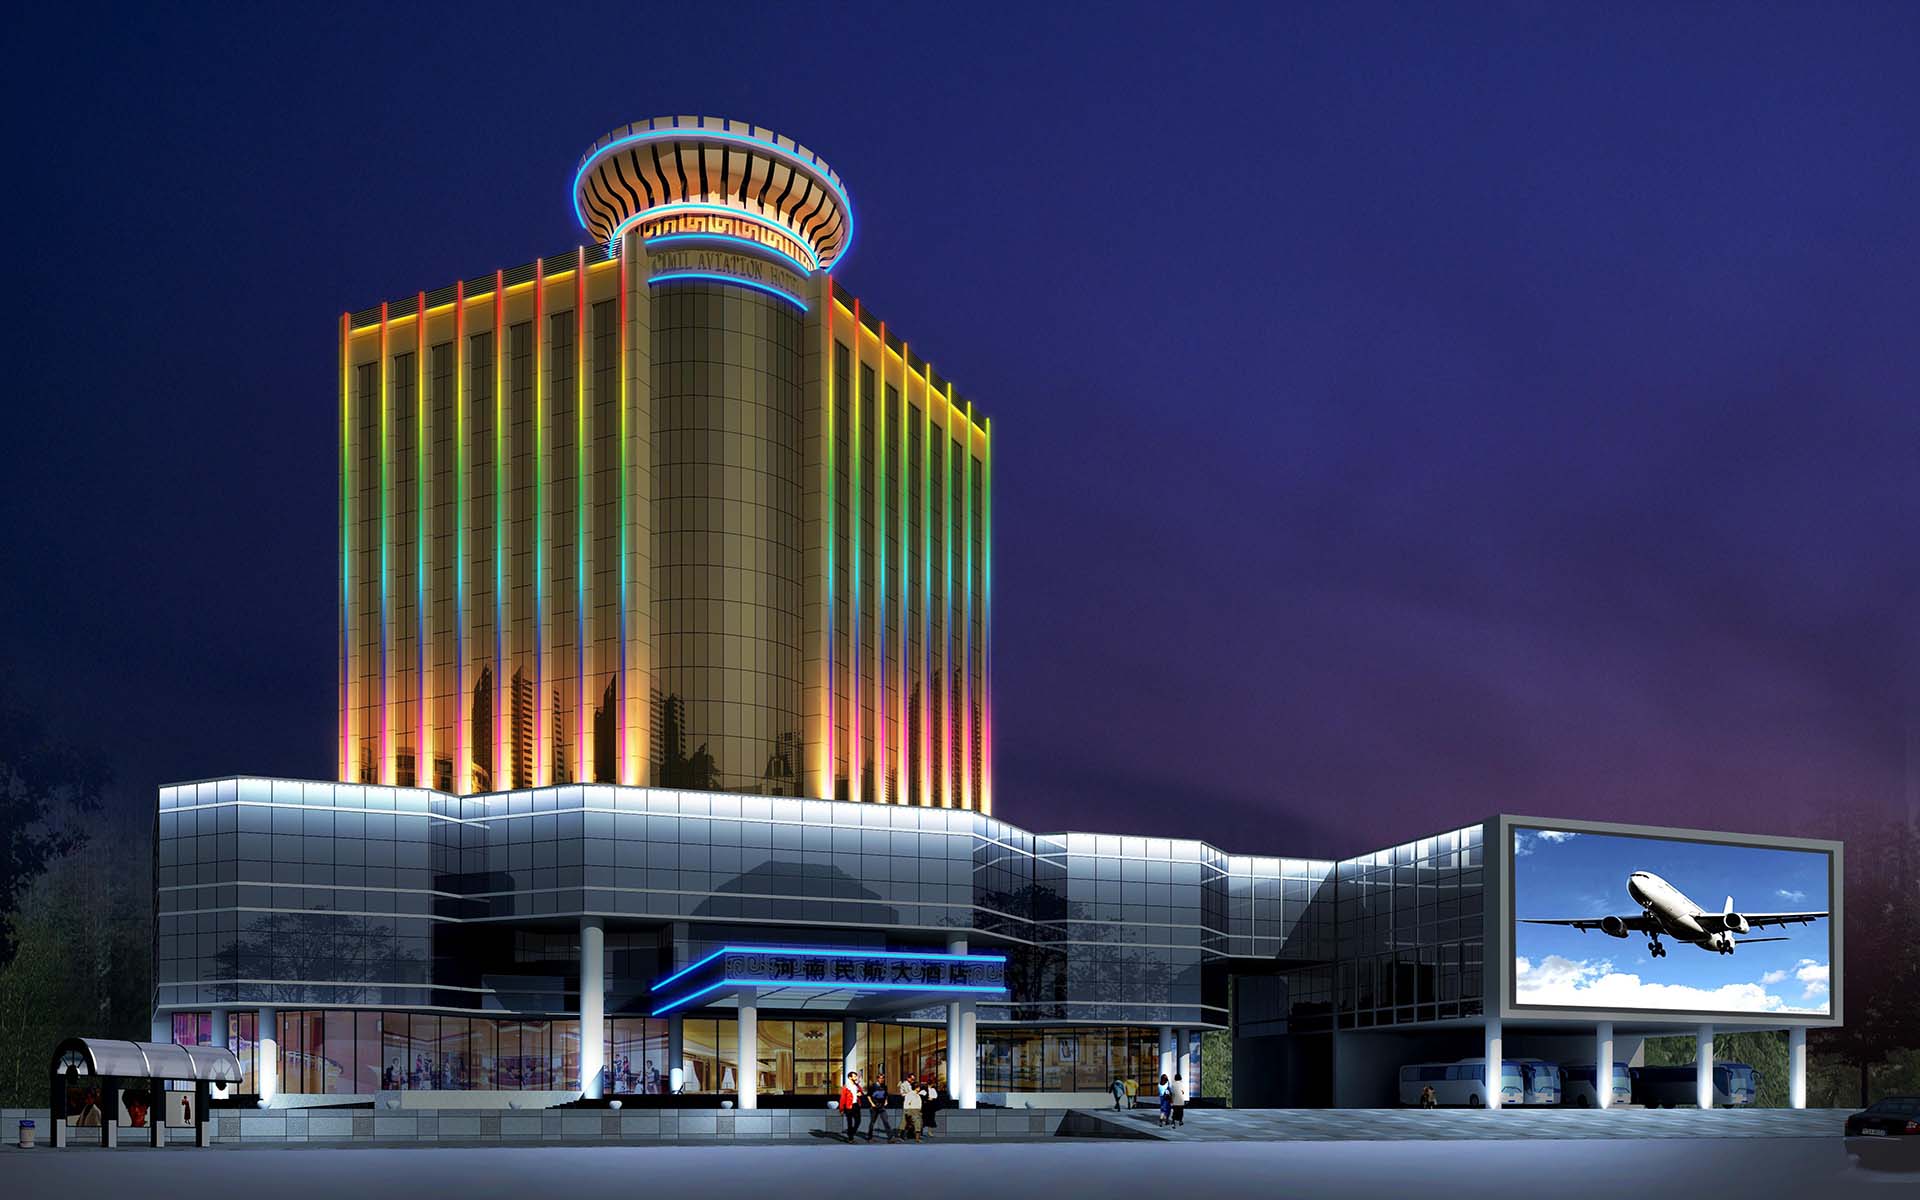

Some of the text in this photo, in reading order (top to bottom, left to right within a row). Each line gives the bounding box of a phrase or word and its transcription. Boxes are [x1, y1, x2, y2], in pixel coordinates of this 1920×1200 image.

[697, 253, 763, 280] AVIATION
[773, 959, 968, 984] 河南民航大酒店
